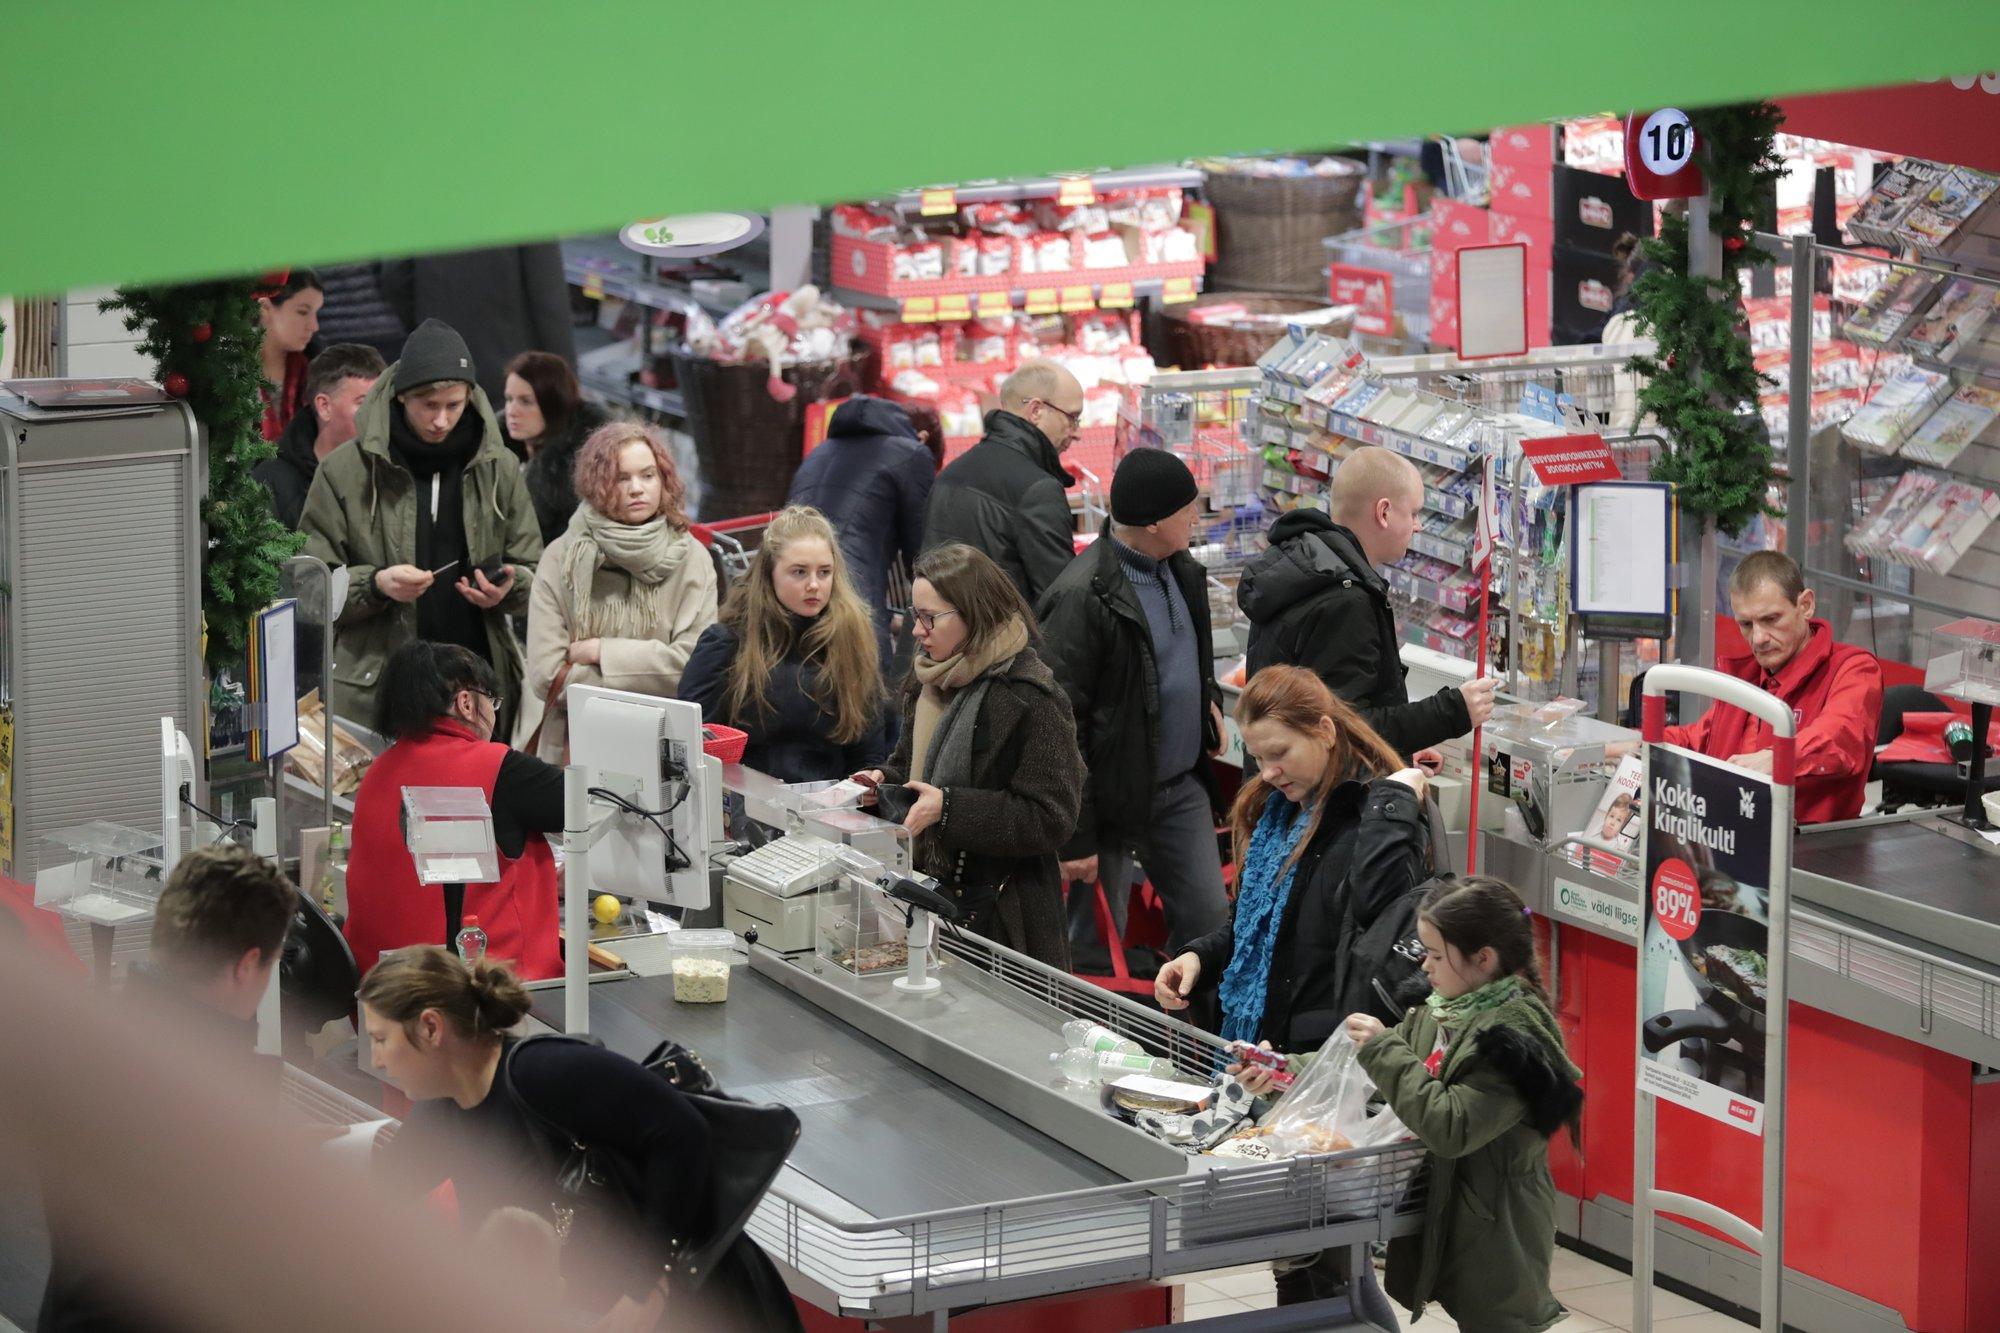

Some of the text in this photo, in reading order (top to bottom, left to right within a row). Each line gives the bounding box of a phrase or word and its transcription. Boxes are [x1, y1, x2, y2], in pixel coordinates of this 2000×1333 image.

[1647, 123, 1686, 162] 10
[1583, 461, 1605, 471] PALUN
[1656, 777, 1706, 817] Kokka
[1655, 804, 1735, 855] kirglikult!
[1591, 902, 1613, 917] väldi
[1656, 885, 1697, 926] 89%
